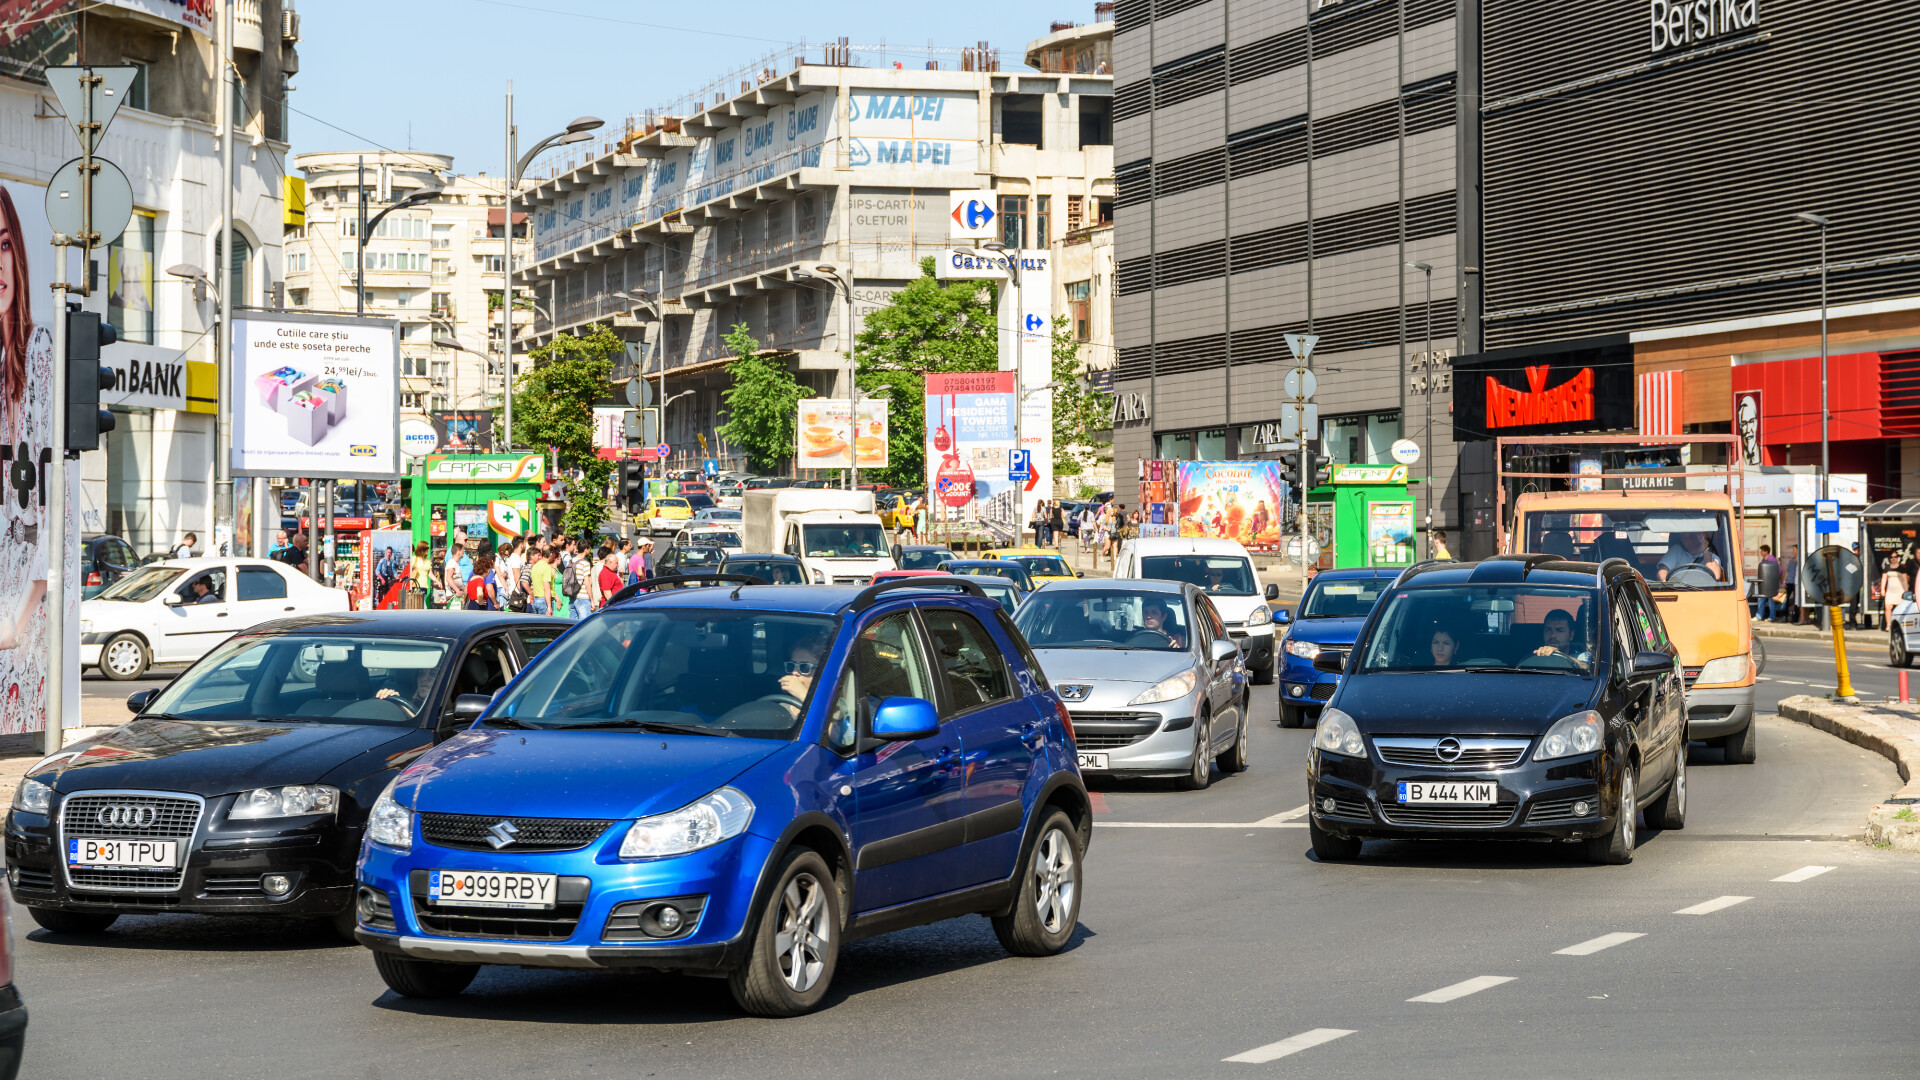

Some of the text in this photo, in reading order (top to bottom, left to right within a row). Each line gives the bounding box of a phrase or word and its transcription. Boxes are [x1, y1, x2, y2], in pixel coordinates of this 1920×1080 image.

[865, 95, 945, 122] MAPEI
[796, 104, 819, 135] MAPEI
[876, 140, 951, 166] MAPEI
[856, 215, 908, 226] GLETURI
[277, 328, 306, 338] Cutiile
[309, 331, 329, 339] care
[254, 340, 277, 348] unde
[280, 342, 300, 350] este
[335, 344, 371, 354] pereche
[946, 406, 1008, 417] RESIDENCE
[1112, 391, 1149, 423] ZARA
[961, 416, 1008, 426] TOWERS
[1252, 423, 1282, 445] ZARA
[439, 462, 512, 473] CATENA
[1078, 755, 1102, 767] CML
[1411, 784, 1491, 801] B 444 KIM
[86, 841, 165, 863] B 31 TPU
[441, 874, 551, 900] B 999 RBY
